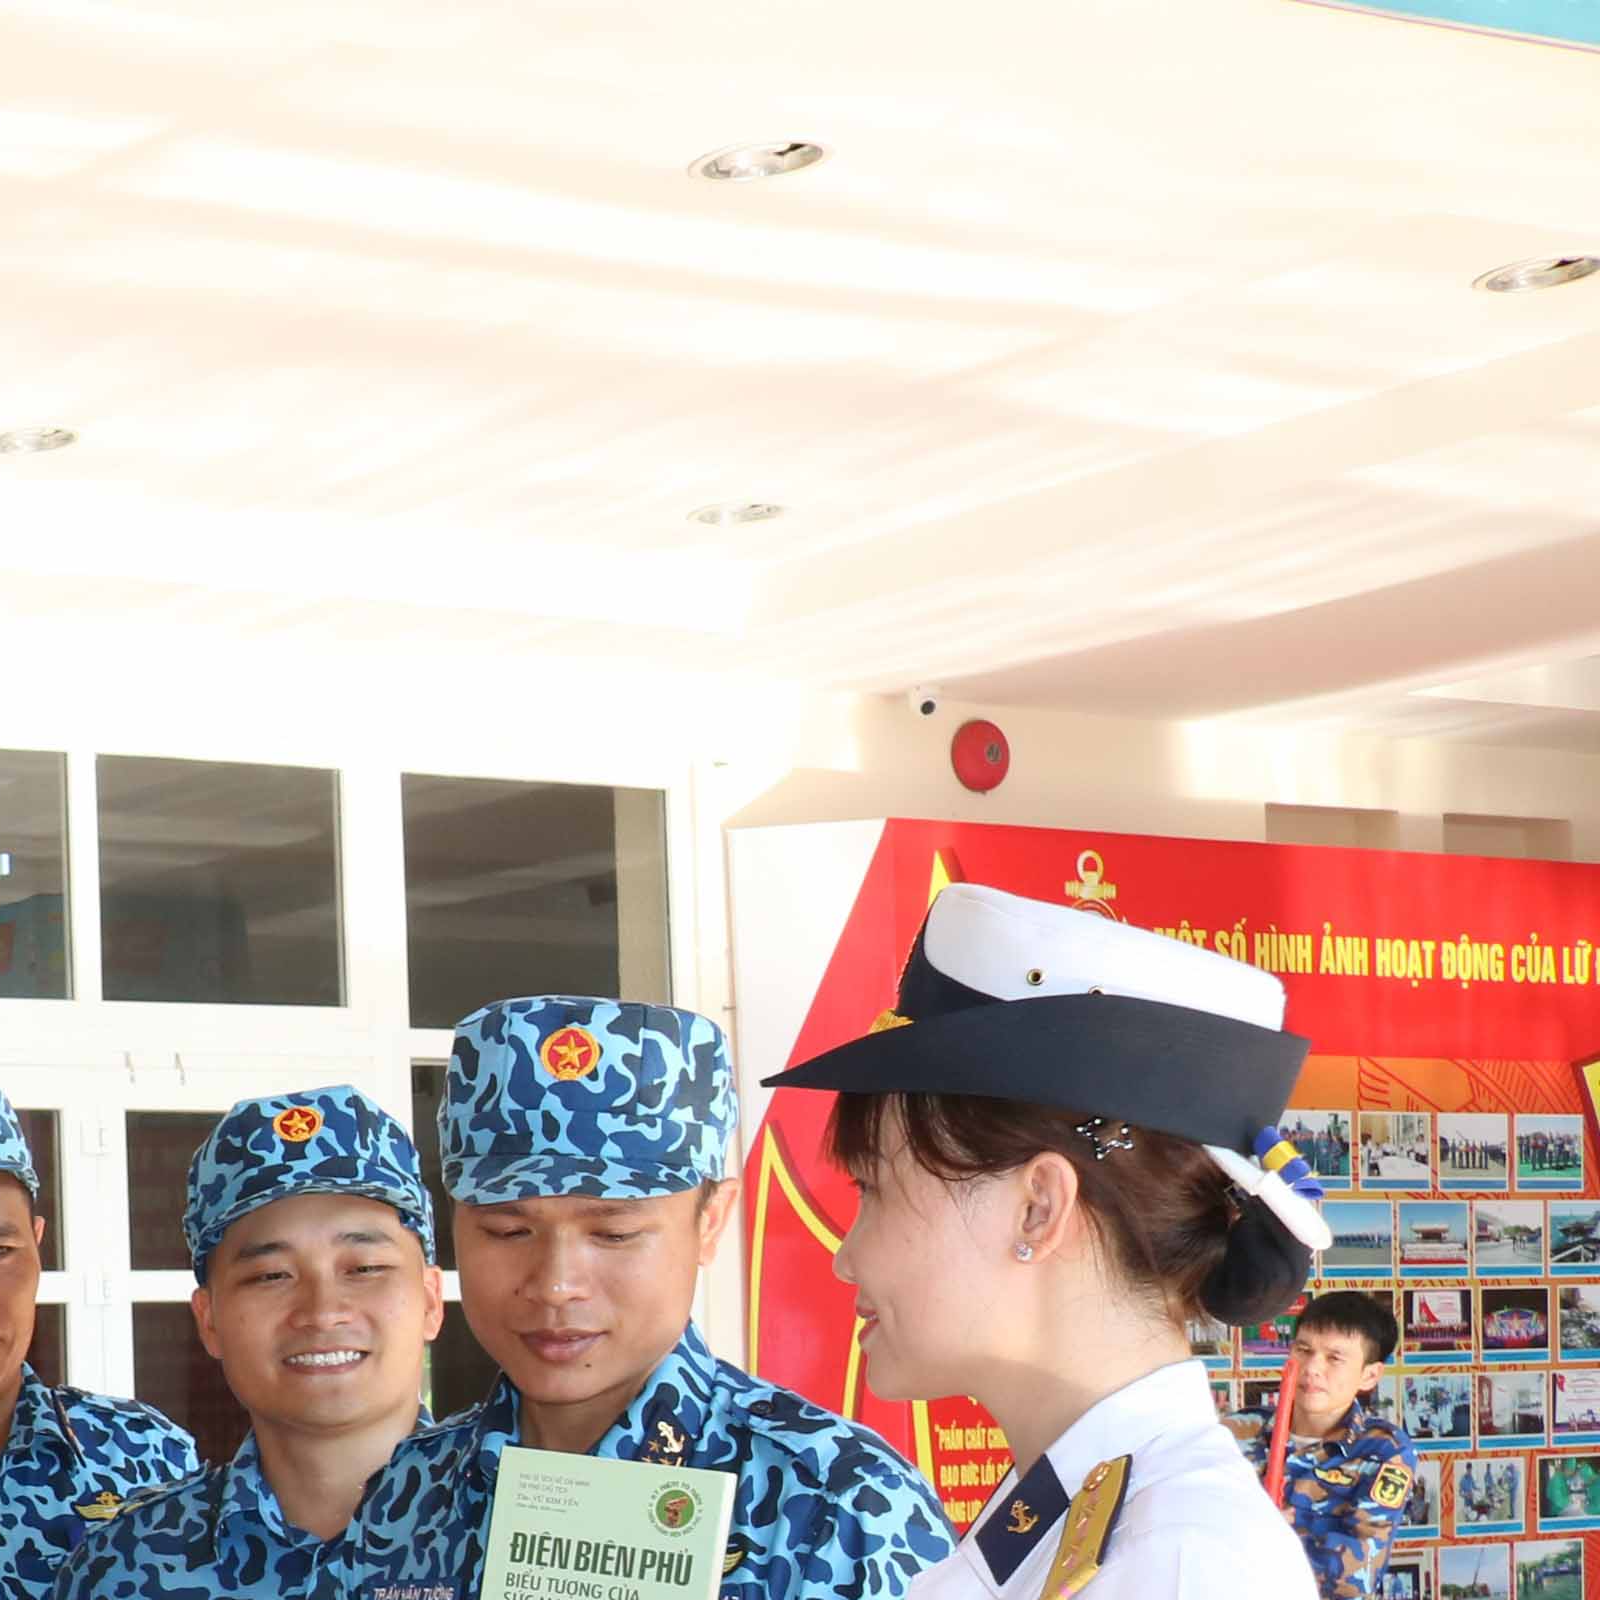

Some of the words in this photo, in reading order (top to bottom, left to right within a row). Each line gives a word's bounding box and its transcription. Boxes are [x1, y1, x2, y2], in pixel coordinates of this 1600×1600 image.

[1255, 925, 1312, 973] HÌNH
[1320, 922, 1368, 976] ẢNH
[1376, 938, 1435, 987] HOẠT
[1442, 934, 1504, 988] ĐỘNG
[1511, 933, 1557, 984] CỦA
[1562, 939, 1592, 984] LỮ
[505, 1569, 541, 1591] BIỂU
[546, 1577, 603, 1600] TƯỢNG
[509, 1531, 572, 1570] ĐIỆN
[573, 1539, 636, 1578] BIÊN
[639, 1547, 693, 1586] PHỦ
